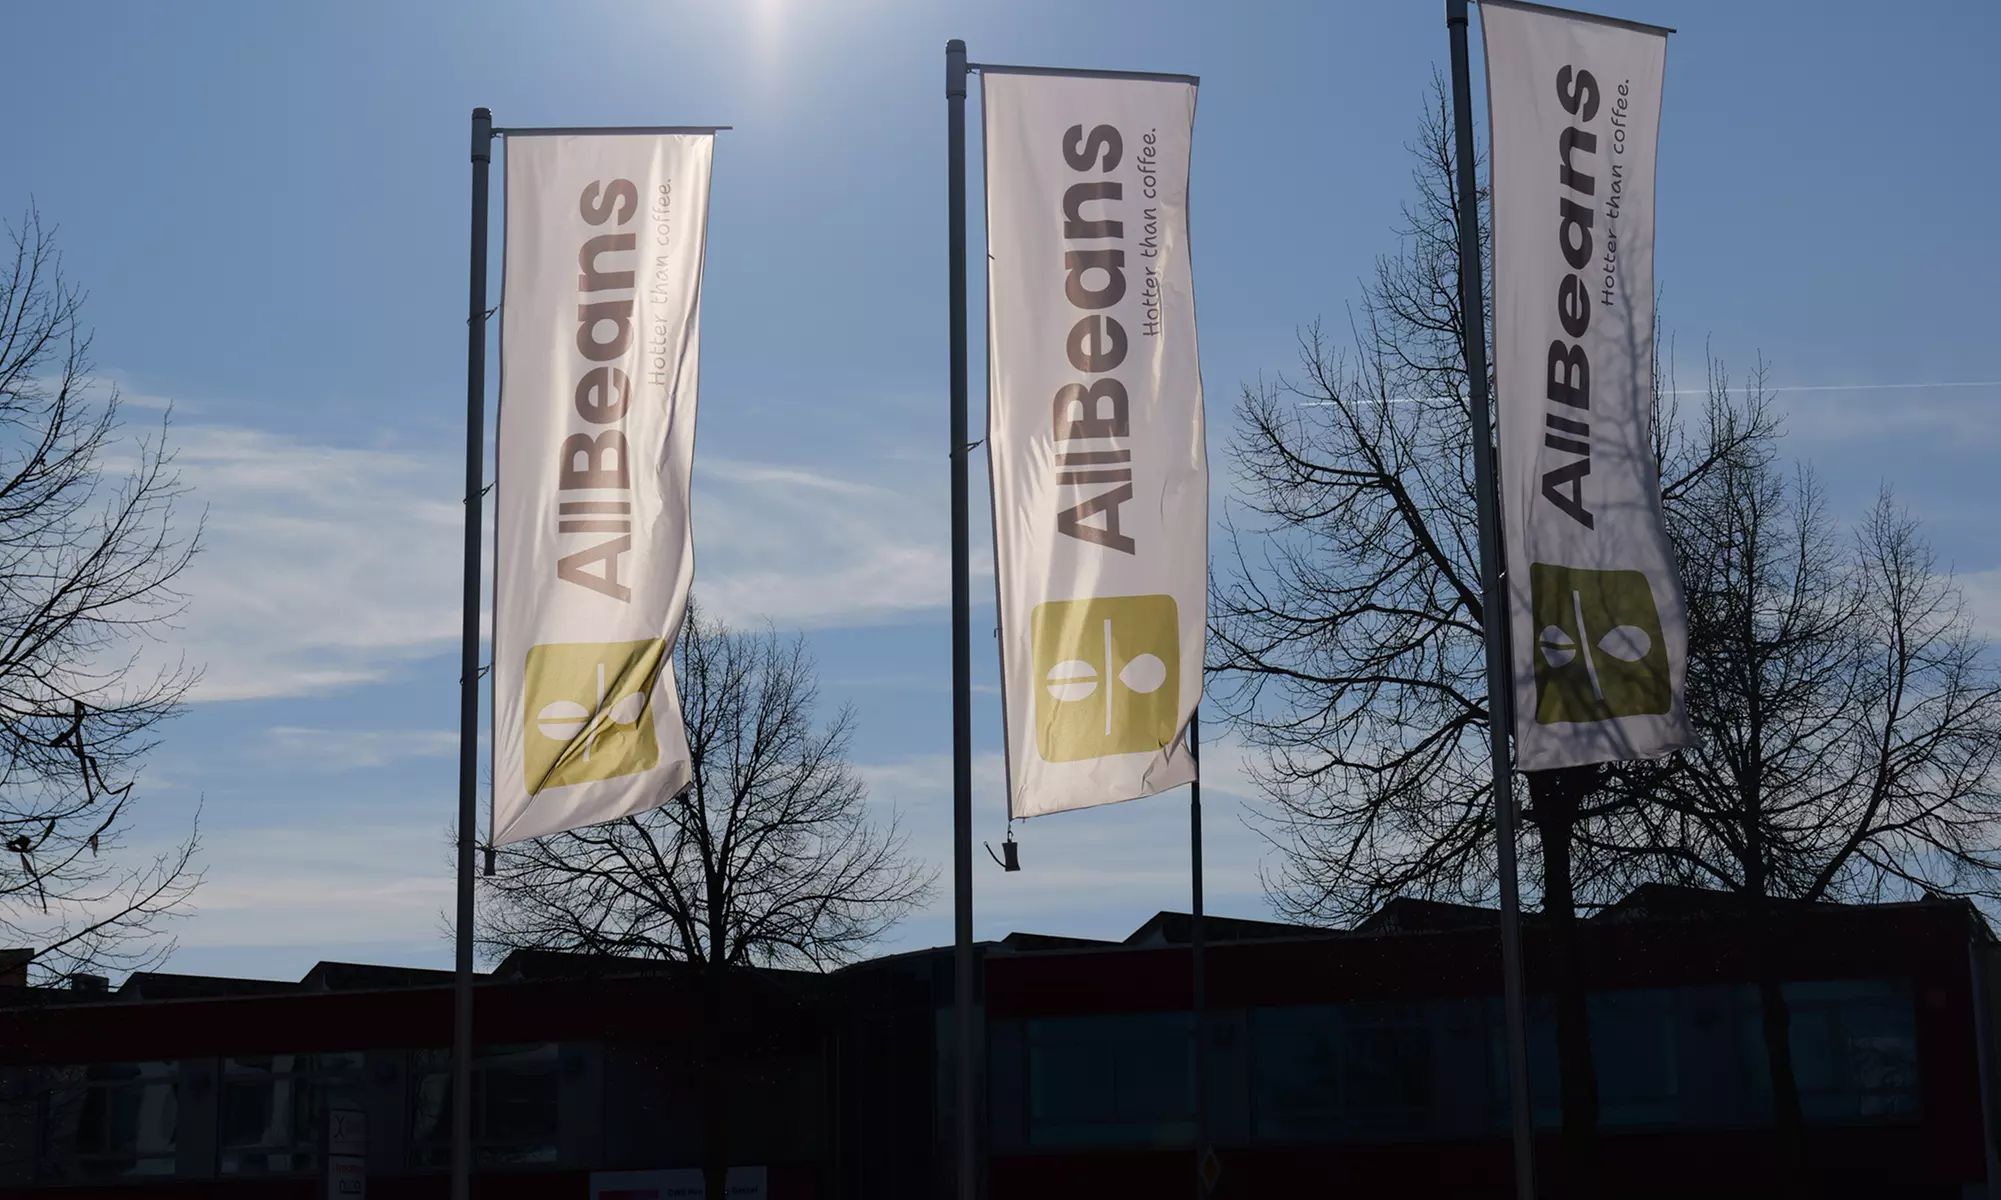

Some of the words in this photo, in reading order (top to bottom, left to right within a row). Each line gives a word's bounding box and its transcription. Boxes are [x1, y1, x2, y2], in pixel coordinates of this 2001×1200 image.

[1611, 78, 1630, 155] coffee.
[1136, 127, 1157, 200] coffee.
[1605, 164, 1623, 219] than
[651, 178, 672, 246] coffee.
[1139, 207, 1158, 258] than
[650, 254, 669, 305] than
[1142, 265, 1159, 337] Hotter
[1542, 64, 1600, 531] AllBeans
[1601, 227, 1618, 306] Hotter
[648, 313, 668, 386] Hotter
[1052, 123, 1136, 556] AllBeans
[557, 178, 639, 605] AllBeans
